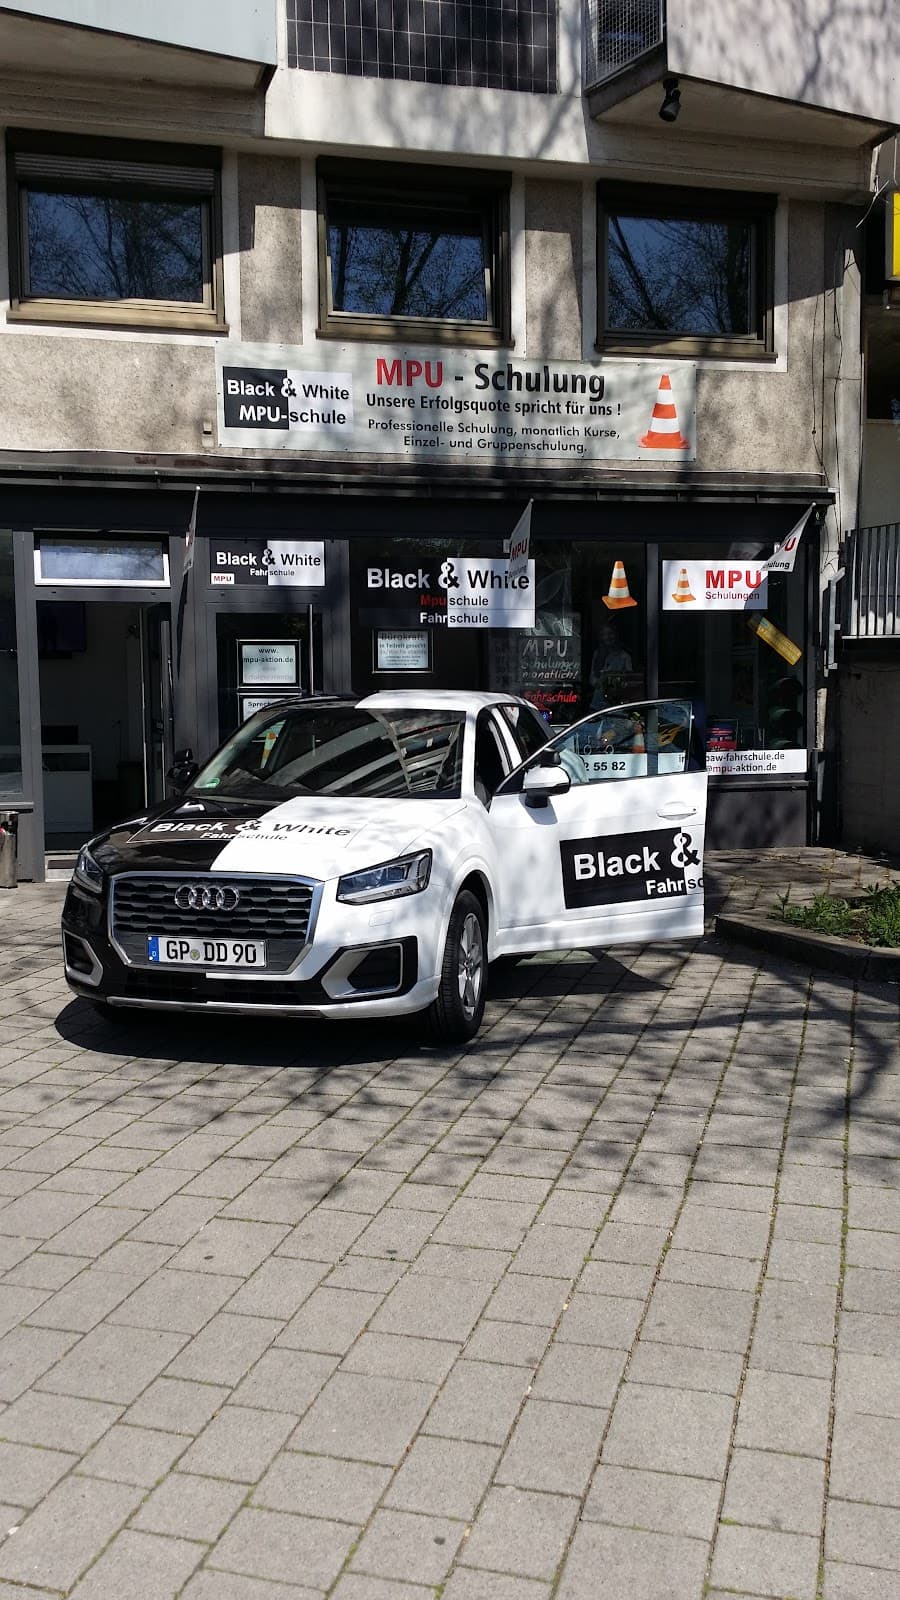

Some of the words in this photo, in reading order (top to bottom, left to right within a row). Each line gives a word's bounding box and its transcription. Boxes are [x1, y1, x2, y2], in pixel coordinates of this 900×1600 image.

[227, 379, 276, 397] Black
[280, 377, 296, 398] &
[302, 384, 350, 400] White
[376, 358, 443, 388] MPU
[474, 363, 605, 402] Schulung
[366, 393, 416, 409] Unsere
[420, 395, 510, 414] Erfolgsquote
[514, 401, 562, 416] spricht
[565, 400, 585, 416] für
[589, 405, 613, 416] uns
[239, 405, 346, 424] MPU-schule
[368, 418, 454, 433] Professionelle
[458, 422, 518, 438] Schulung,
[522, 426, 580, 437] monatlich
[584, 427, 620, 439] Kurse,
[404, 436, 444, 448] Einzel-
[450, 438, 472, 448] und
[216, 552, 258, 566] Black
[262, 548, 276, 566] &
[280, 553, 321, 566] White
[367, 568, 430, 589] Black
[438, 562, 460, 589] &
[705, 570, 762, 589] MPU
[705, 591, 760, 602] Schulungen
[522, 639, 568, 658] MPU
[243, 656, 294, 664] mpu-aktion.de
[593, 762, 608, 771] 55
[612, 761, 626, 770] 82
[150, 822, 230, 833] Black
[234, 819, 263, 832] &
[273, 823, 351, 837] White
[200, 832, 288, 841] Fahrschule
[573, 846, 662, 881] Black
[670, 832, 702, 869] &
[166, 940, 190, 960] GP
[203, 942, 228, 962] DD
[232, 944, 257, 964] 90
